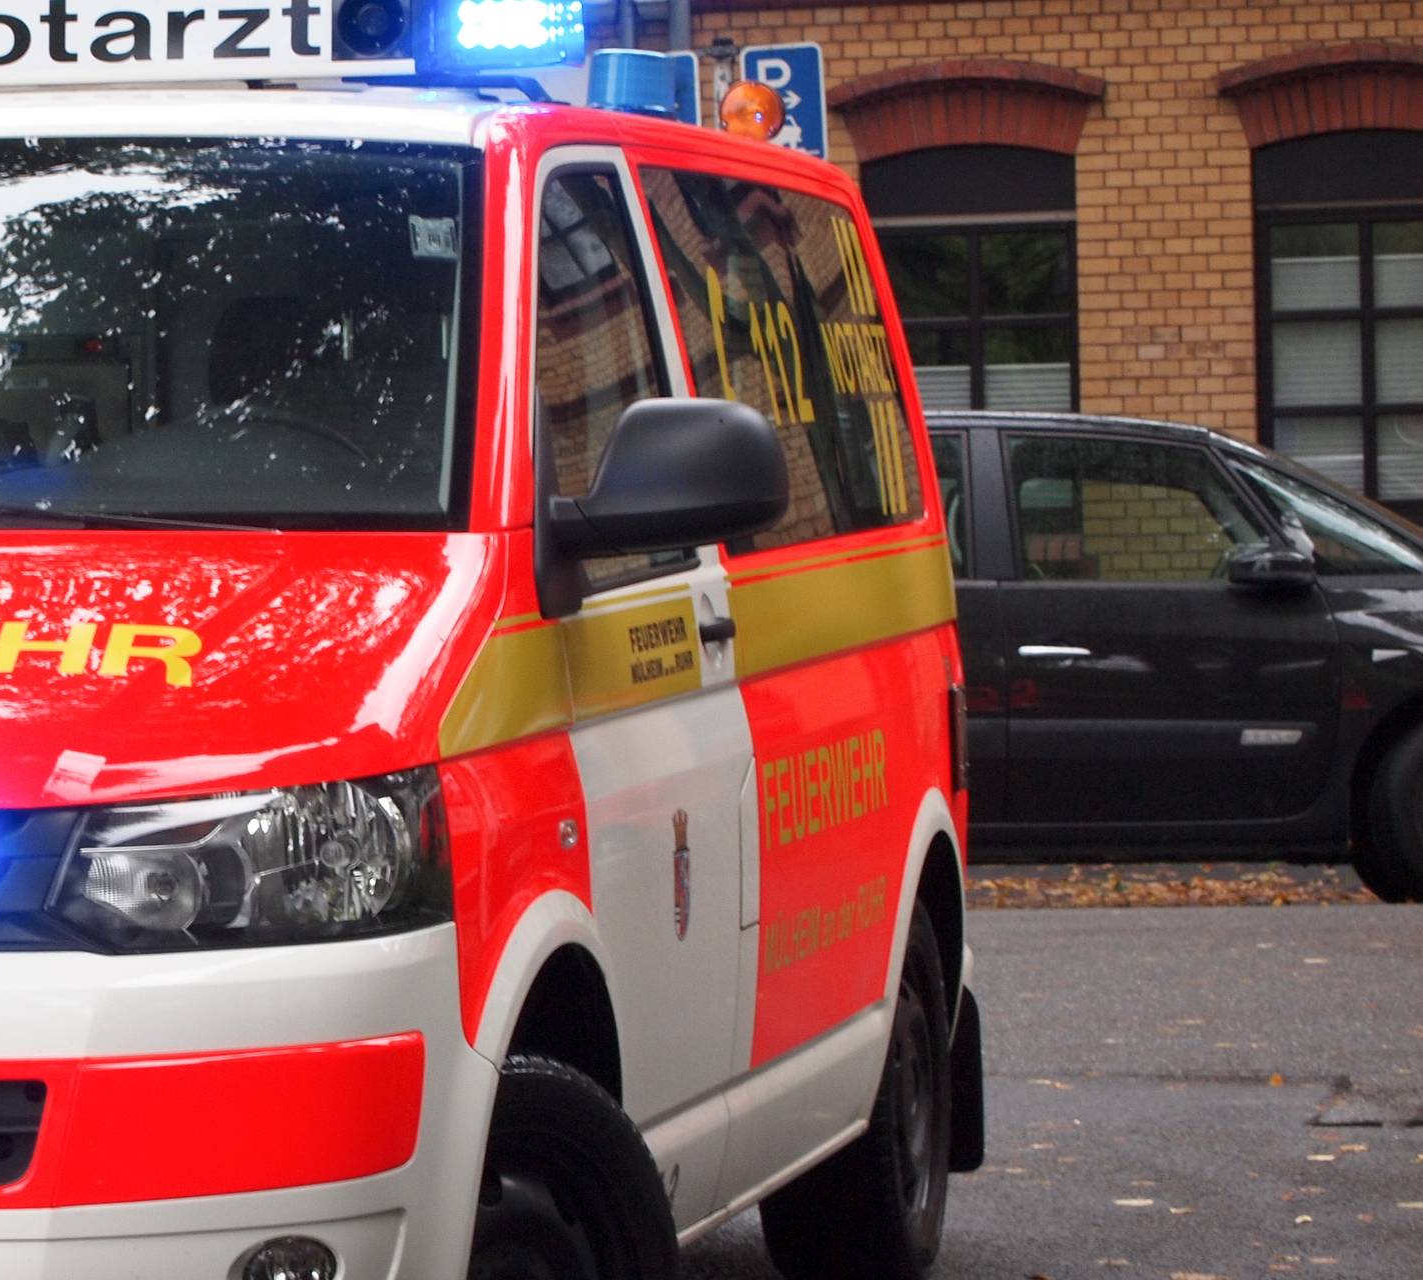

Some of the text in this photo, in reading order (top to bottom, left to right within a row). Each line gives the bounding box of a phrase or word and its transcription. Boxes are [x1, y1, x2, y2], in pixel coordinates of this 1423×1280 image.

[756, 58, 792, 89] P
[749, 302, 816, 425] 112
[820, 322, 897, 394] NOTARZT
[629, 616, 688, 654] FEUERWEHR
[762, 729, 889, 849] FEUERWEHR
